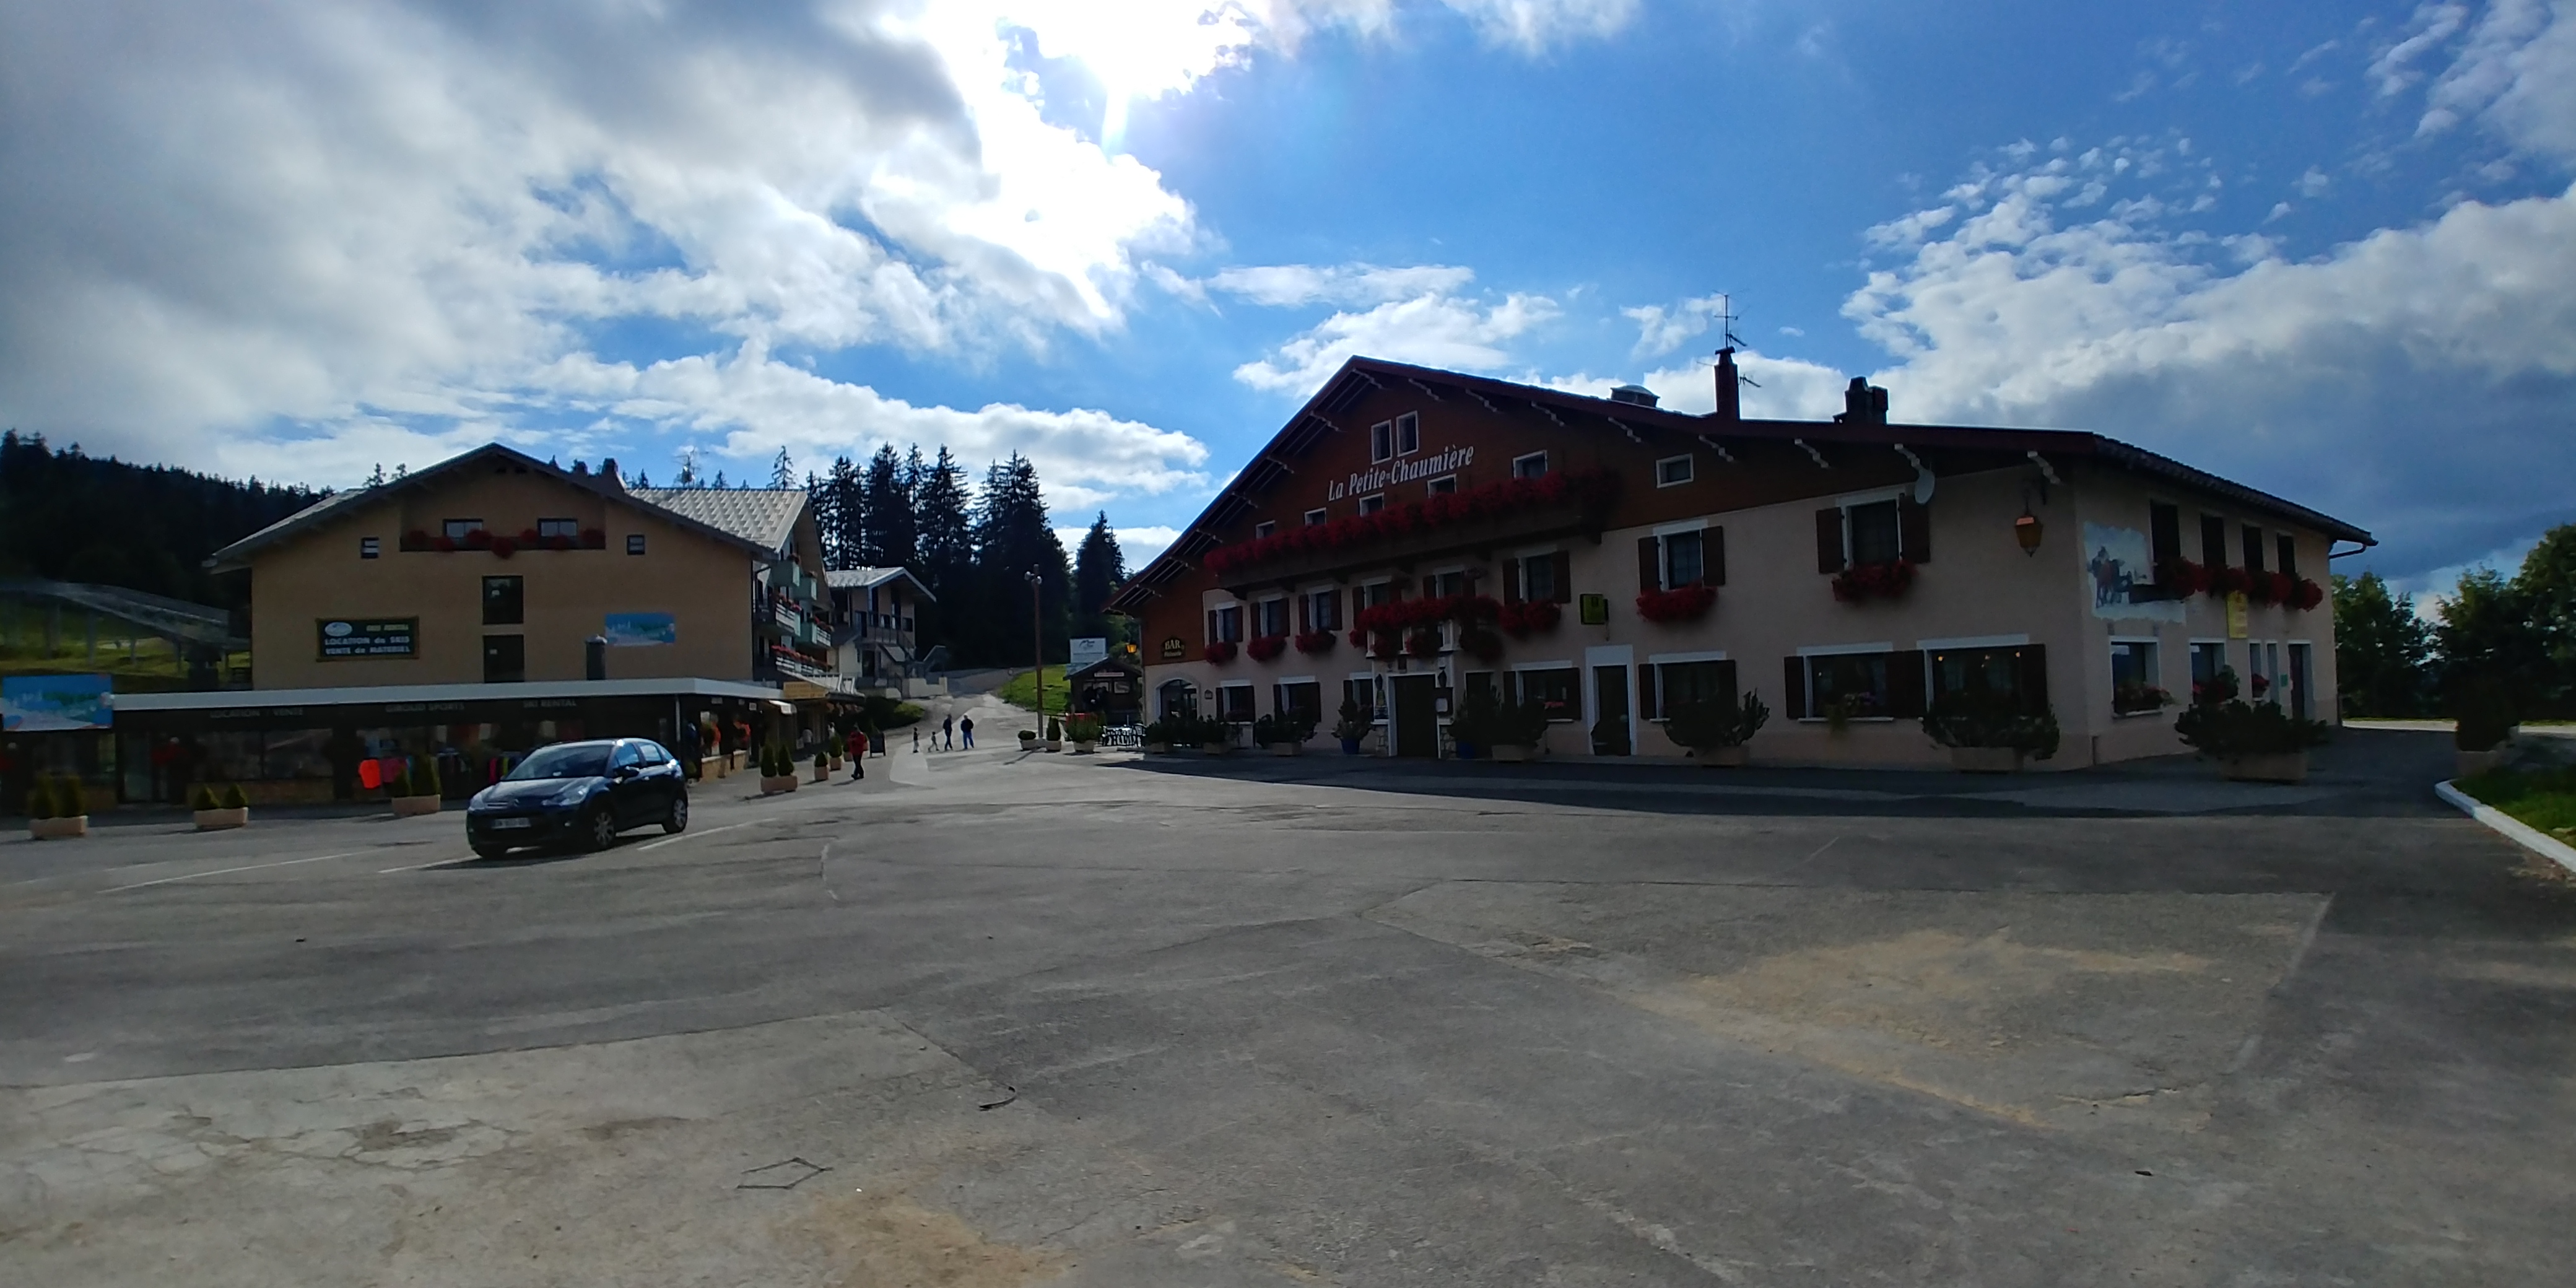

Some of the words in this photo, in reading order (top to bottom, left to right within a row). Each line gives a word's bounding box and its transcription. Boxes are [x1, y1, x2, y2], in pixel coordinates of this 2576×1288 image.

[1328, 480, 1343, 501] La
[1165, 639, 1180, 650] BAR
[427, 702, 464, 711] SPORTS
[541, 698, 577, 707] RENTAL
